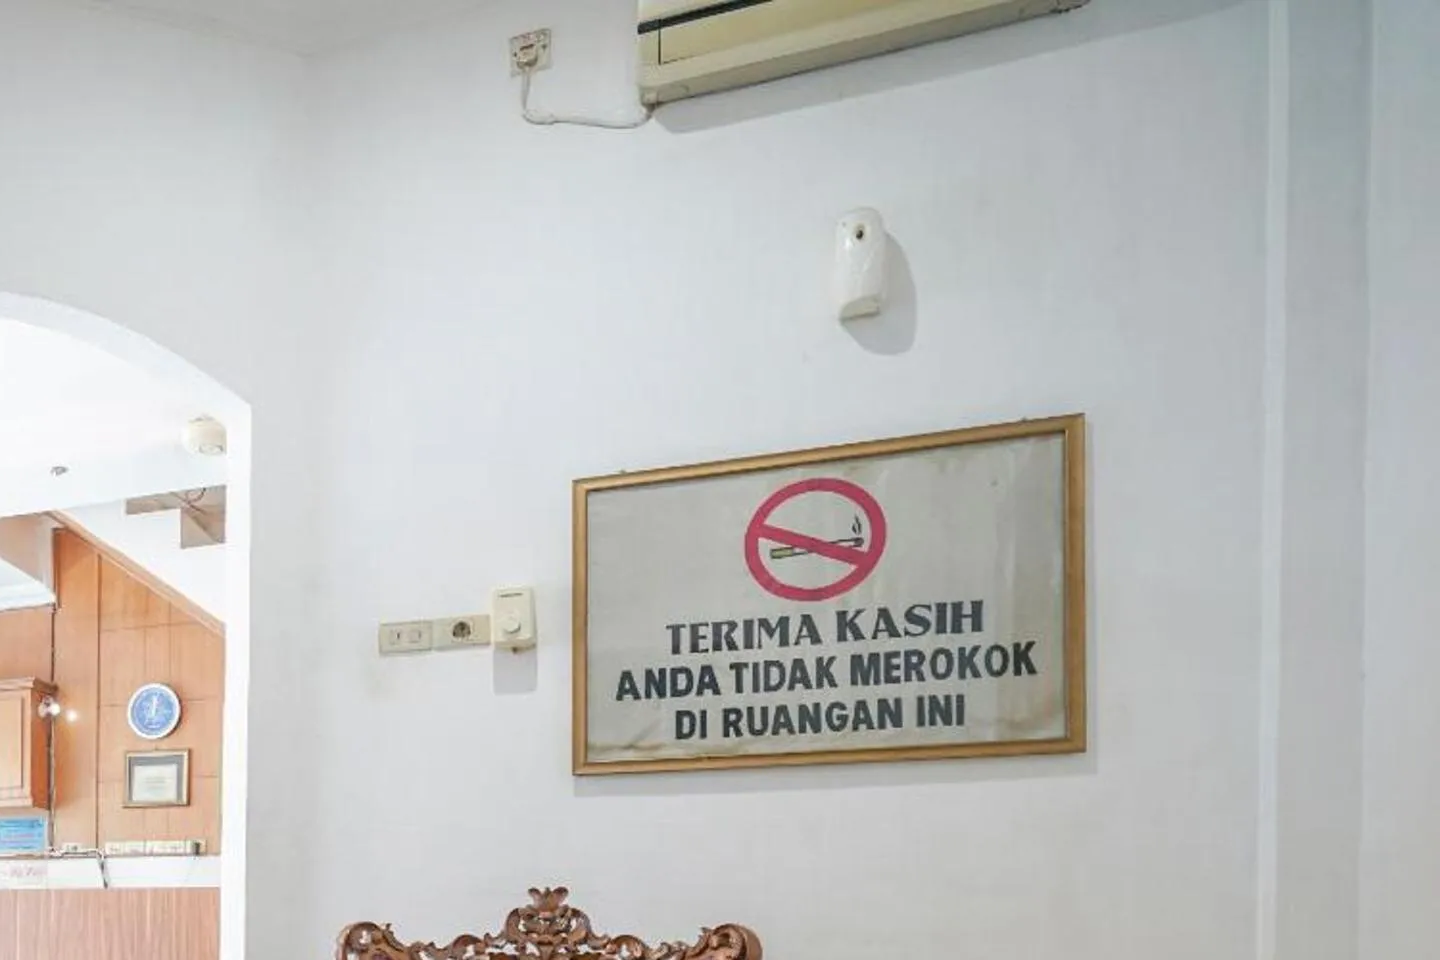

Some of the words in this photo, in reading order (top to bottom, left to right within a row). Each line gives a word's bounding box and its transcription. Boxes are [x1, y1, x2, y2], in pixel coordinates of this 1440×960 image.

[666, 614, 822, 655] TERIMA
[836, 599, 984, 642] KASIH
[615, 665, 721, 701] ANDA
[729, 655, 838, 694] TIDAK
[850, 641, 1037, 686] MEROKOK
[674, 709, 707, 740] DI
[722, 697, 903, 738] RUANGAN
[917, 693, 965, 727] INI
